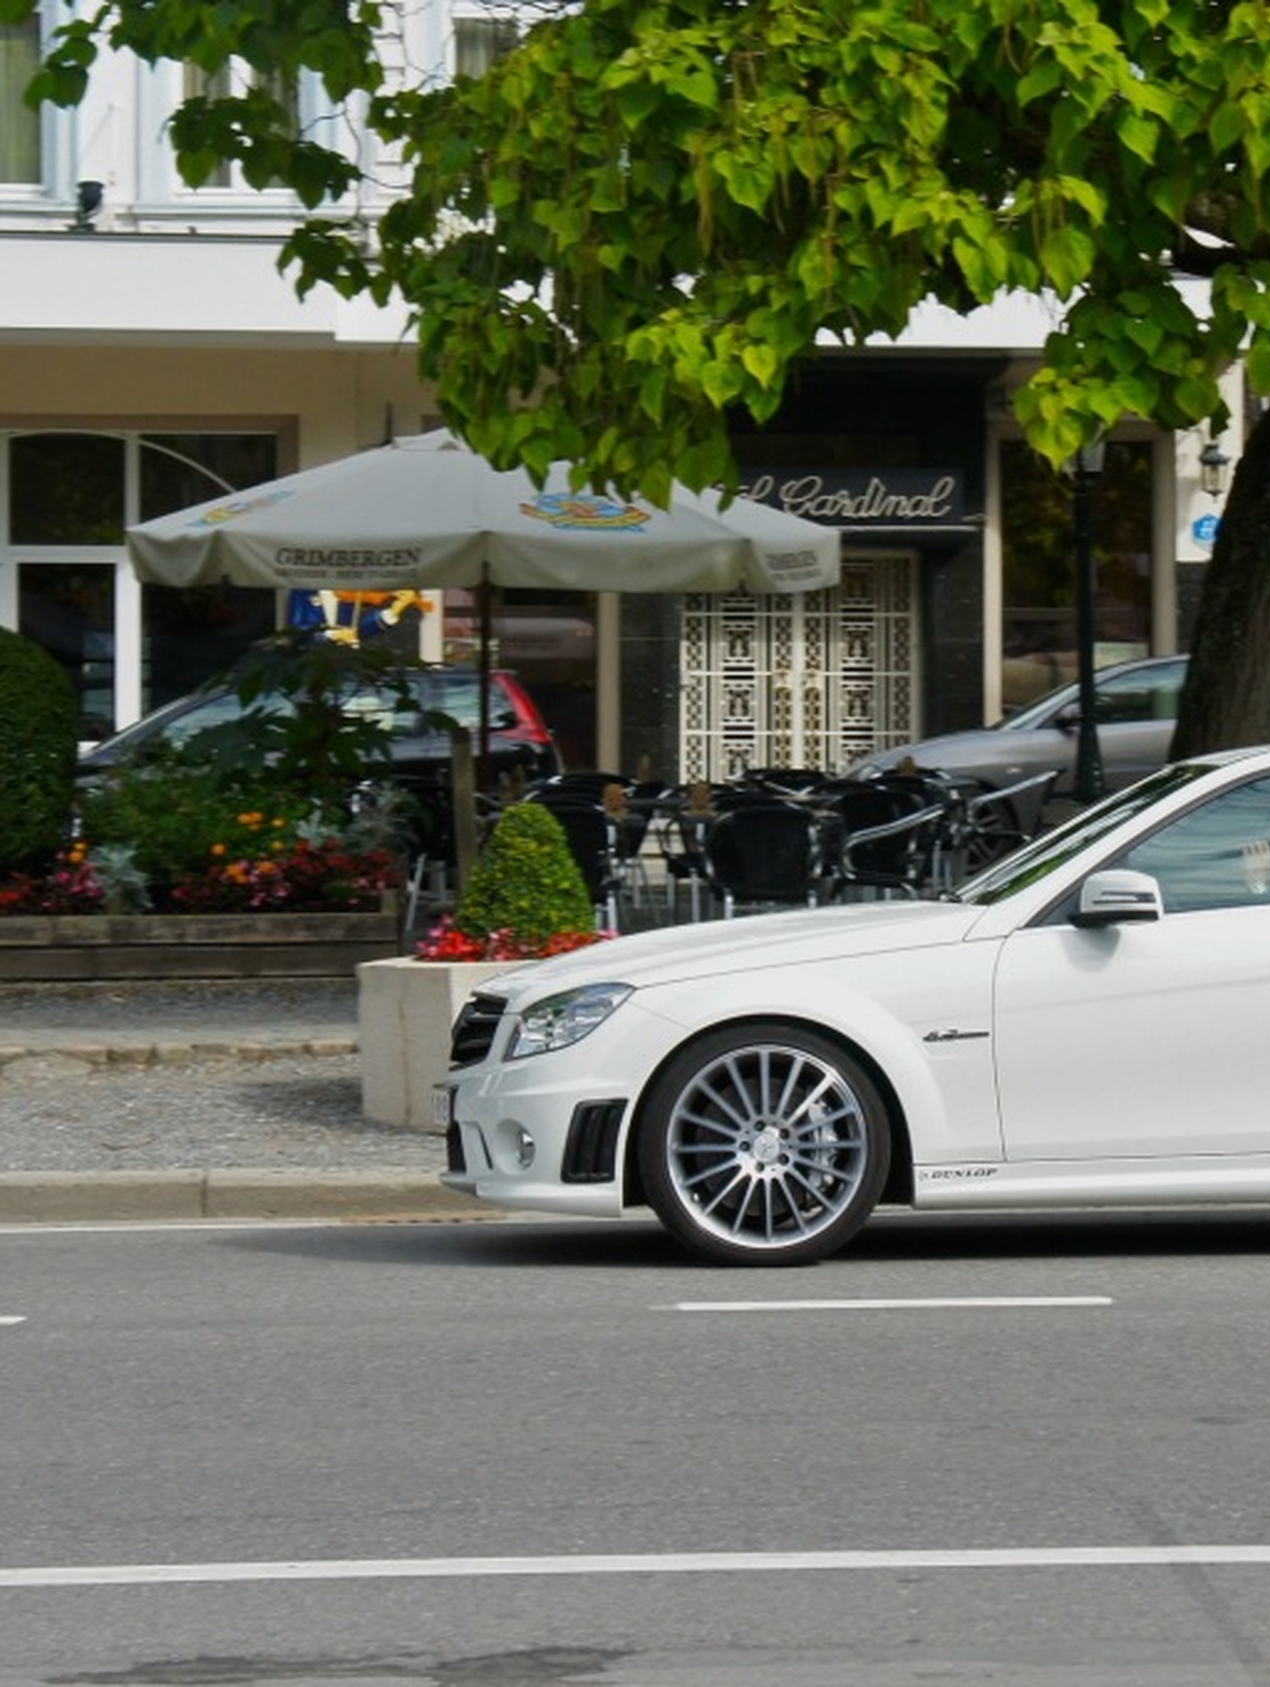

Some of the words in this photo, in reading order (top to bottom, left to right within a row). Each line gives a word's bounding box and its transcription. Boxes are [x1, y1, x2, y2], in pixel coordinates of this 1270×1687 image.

[778, 475, 956, 518] Cardinal
[275, 547, 423, 567] GRIMBERGEN
[931, 1167, 998, 1180] DUNLOP
